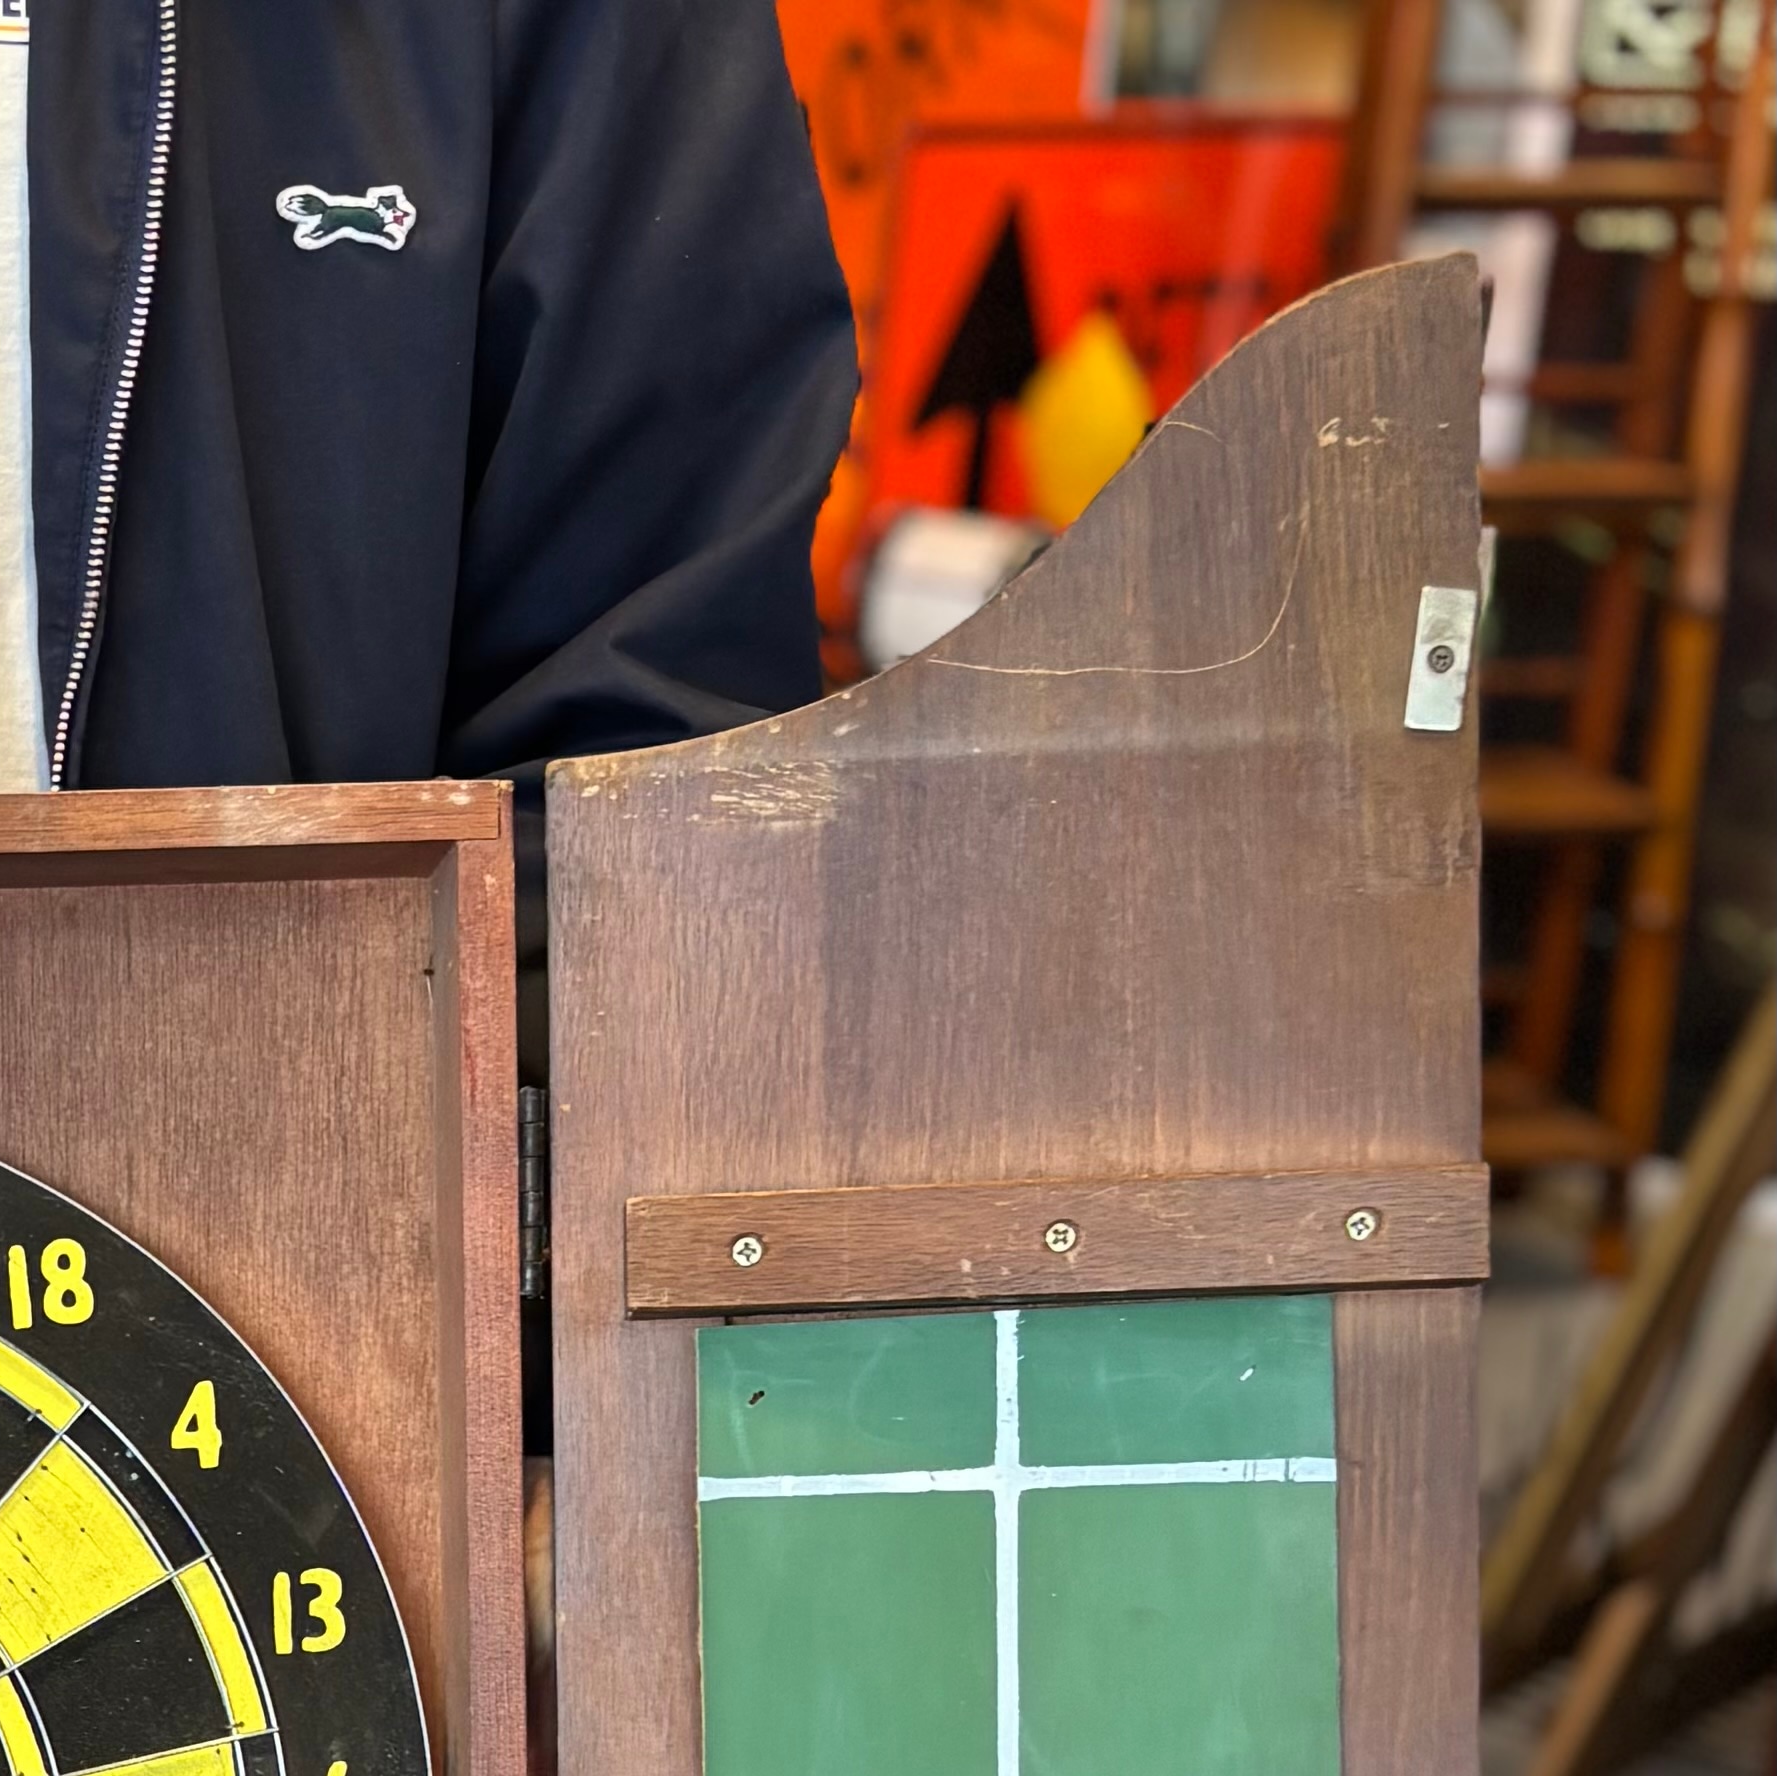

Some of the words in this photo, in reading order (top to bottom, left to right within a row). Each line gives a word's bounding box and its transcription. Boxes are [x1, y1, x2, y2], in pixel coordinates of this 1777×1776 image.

[8, 1238, 94, 1330] 18
[170, 1381, 222, 1469] 4
[272, 1569, 345, 1655] 13
